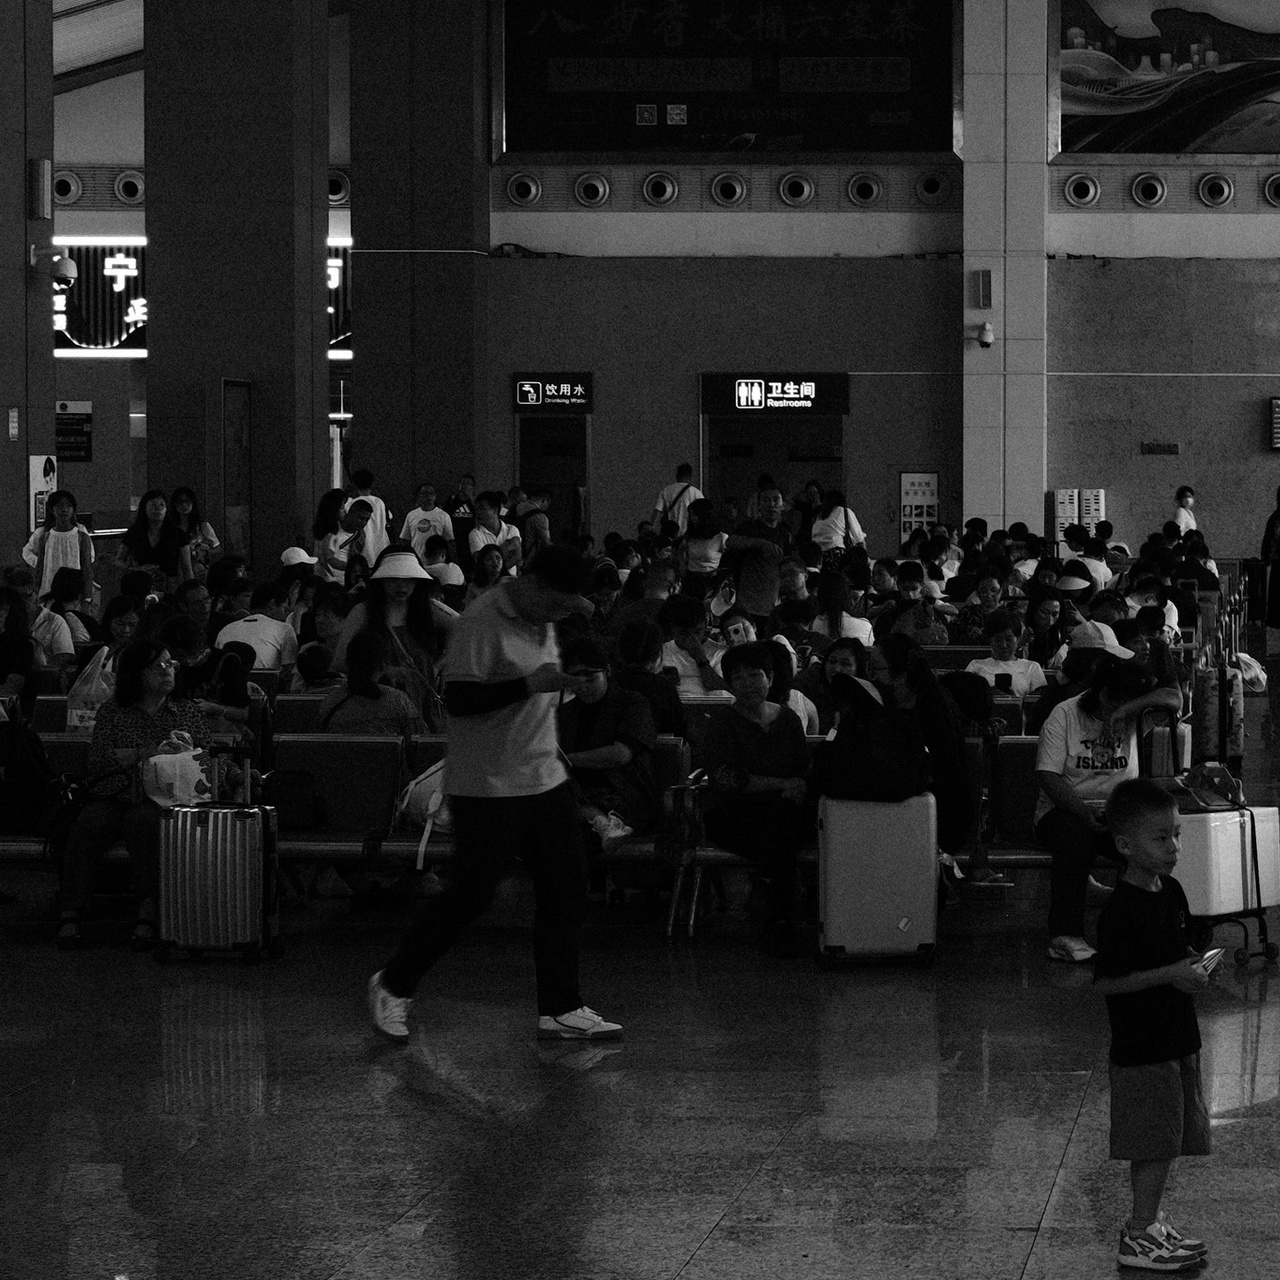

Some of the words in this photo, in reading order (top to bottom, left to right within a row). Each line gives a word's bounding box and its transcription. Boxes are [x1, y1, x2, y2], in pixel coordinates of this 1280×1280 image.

[545, 383, 586, 396] 饮用水
[767, 381, 815, 399] 卫生间
[767, 399, 812, 407] Restrooms
[1075, 755, 1128, 770] ISLAND
